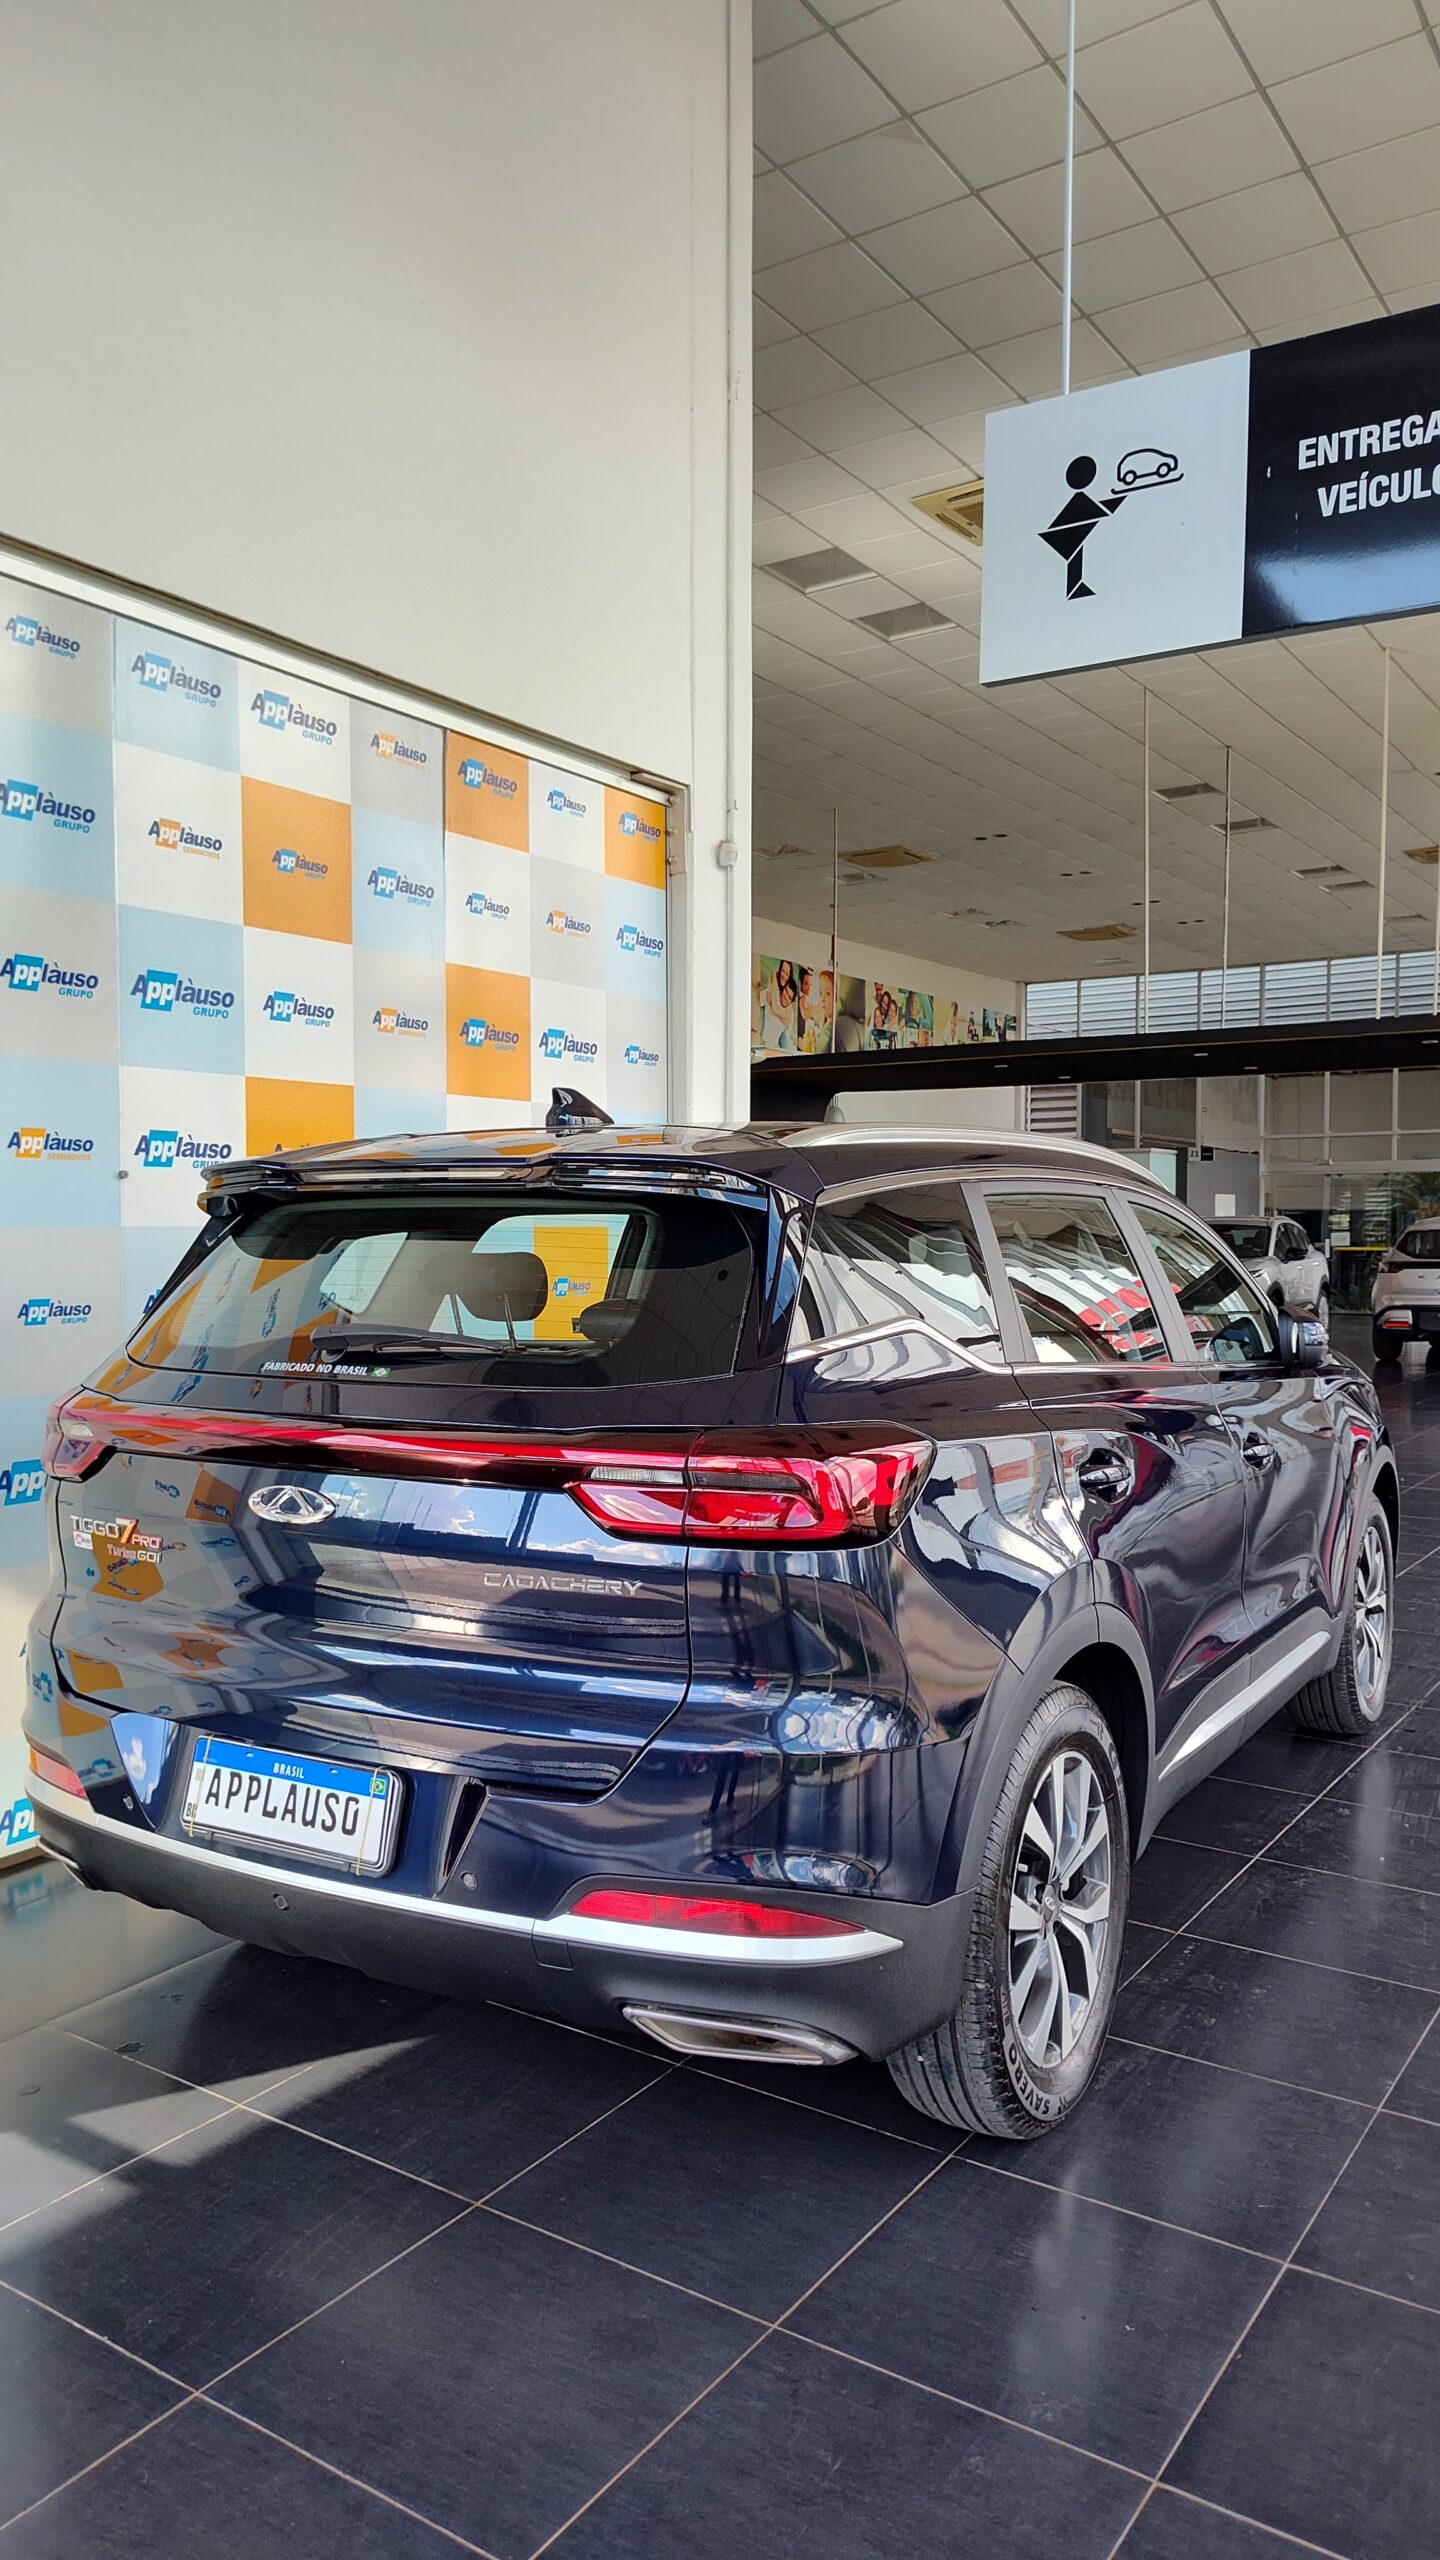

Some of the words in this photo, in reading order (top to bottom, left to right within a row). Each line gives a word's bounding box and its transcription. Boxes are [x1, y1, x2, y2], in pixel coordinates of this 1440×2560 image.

[1298, 410, 1440, 471] ENTREGA
[5, 617, 81, 653] Applàuso
[131, 655, 222, 698] Applàuso
[184, 692, 217, 708] GRUPO
[251, 692, 337, 736] Applàuso
[302, 730, 333, 745] GRUPO
[54, 818, 90, 833] GRUPO
[148, 819, 222, 851] Applàuso
[368, 869, 434, 898] Applàuso
[616, 927, 664, 951] Applàuso
[0, 957, 99, 990] Applàuso
[58, 987, 93, 999] GRUPO
[131, 974, 234, 1008] Applàuso
[193, 1006, 229, 1019] GRUPO
[263, 994, 334, 1020] Applàuso
[305, 1017, 330, 1028] GRUPO
[372, 1010, 428, 1030] Applàuso
[460, 1021, 519, 1044] Applàuso
[539, 1031, 598, 1056] Applàuso
[8, 1130, 94, 1153] Applàuso
[134, 1134, 232, 1160] Applàuso
[47, 1153, 92, 1162] SEMINOVOS
[17, 1299, 91, 1321] Applàuso
[262, 1361, 314, 1373] FABRICADO
[316, 1364, 332, 1374] NO
[333, 1365, 368, 1376] BRASIL
[484, 1572, 643, 1596] CAOACHERY
[273, 1762, 305, 1779] BRASIL
[205, 1768, 360, 1836] APPLAUSO
